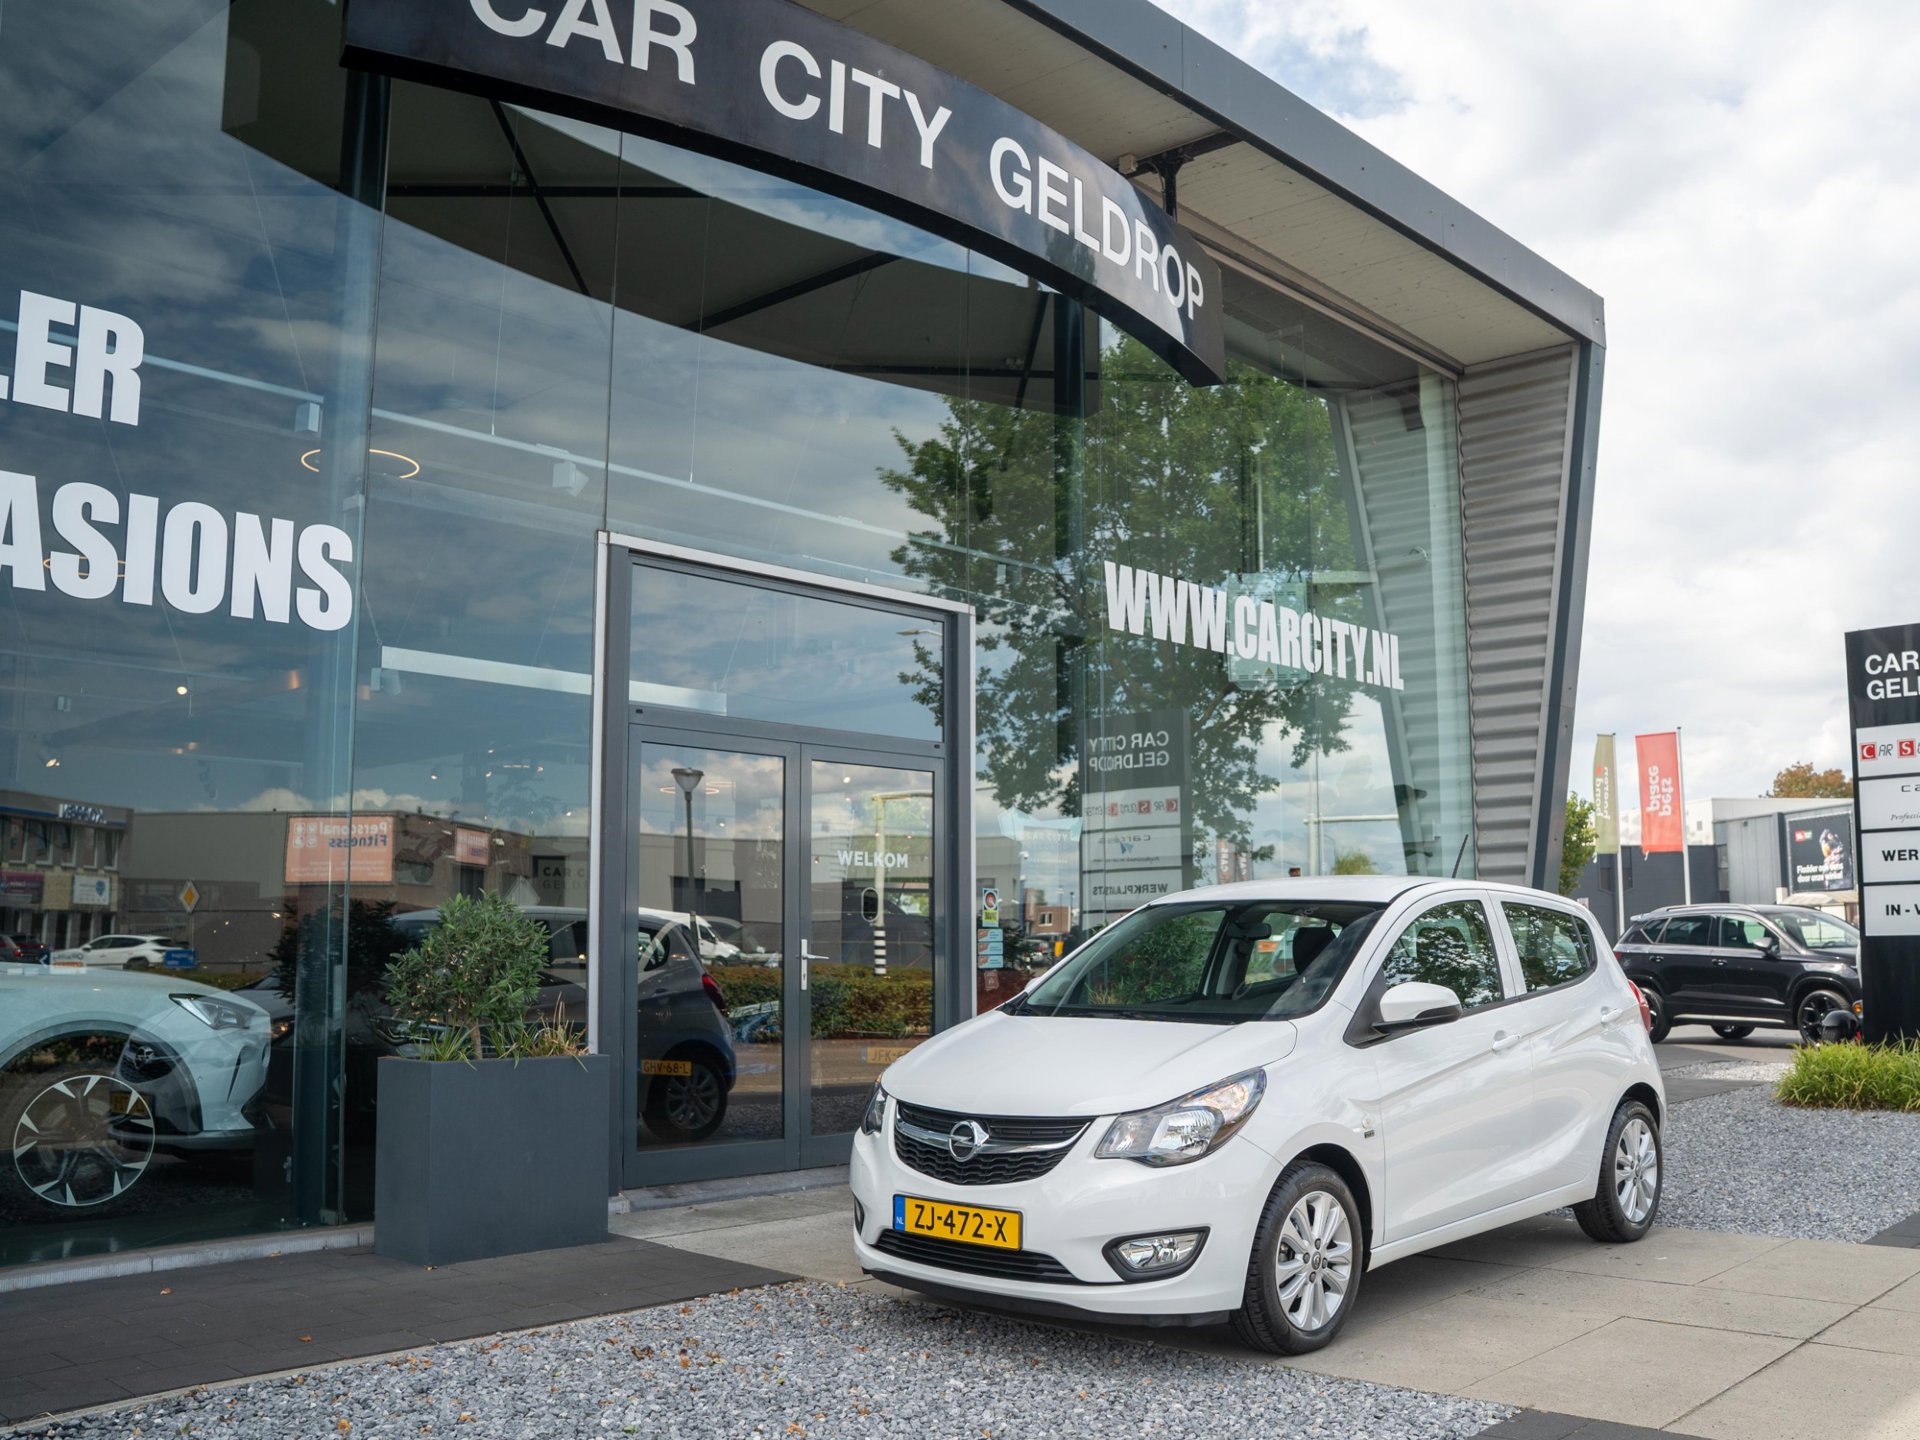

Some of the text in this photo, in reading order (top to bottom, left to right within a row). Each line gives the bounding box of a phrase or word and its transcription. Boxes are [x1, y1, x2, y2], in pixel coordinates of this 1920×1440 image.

[760, 40, 952, 169] CITY
[990, 137, 1204, 320] GELDROP
[0, 289, 145, 426] ER
[1104, 560, 1404, 680] WWW.CARCITY.NL
[1865, 650, 1920, 675] CAR
[1866, 675, 1920, 700] GEL
[1899, 739, 1920, 758] S
[837, 850, 908, 868] WELKOM
[1881, 849, 1919, 861] WER
[1885, 904, 1901, 915] IN
[914, 1204, 1007, 1242] ZJ-472-X
